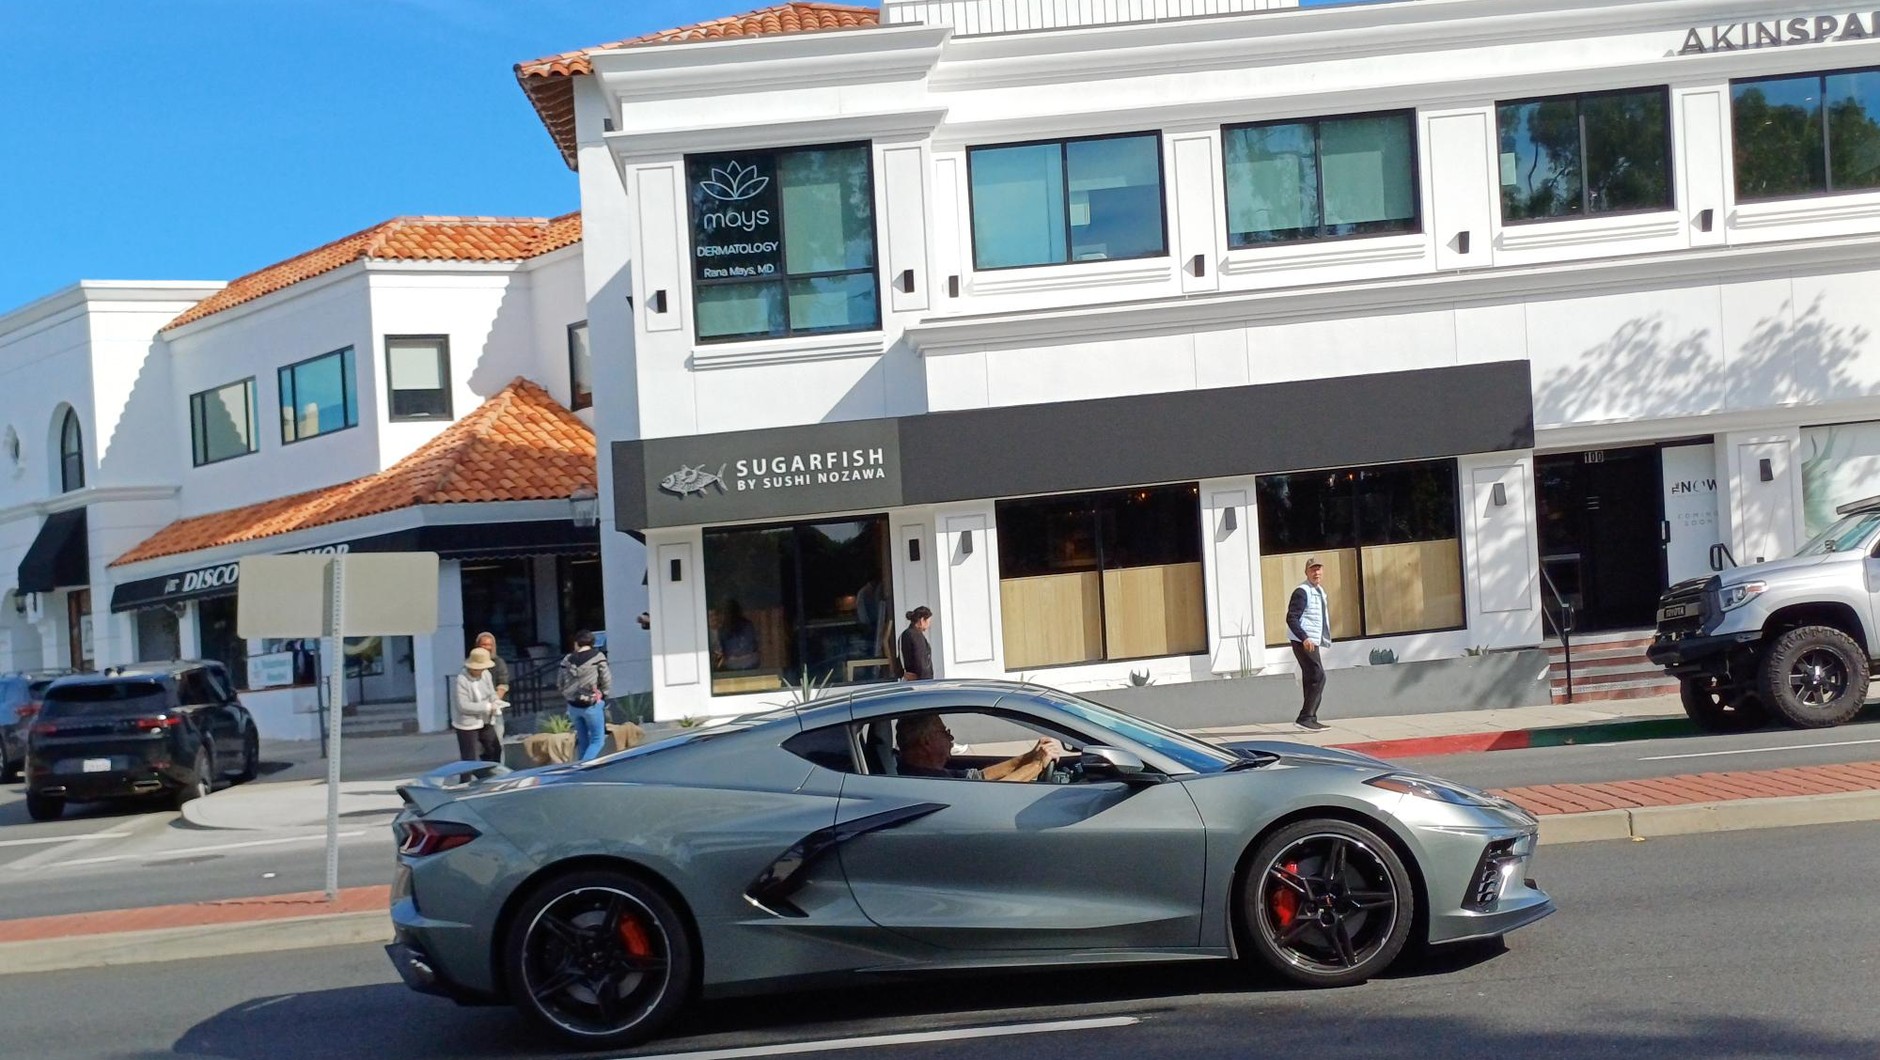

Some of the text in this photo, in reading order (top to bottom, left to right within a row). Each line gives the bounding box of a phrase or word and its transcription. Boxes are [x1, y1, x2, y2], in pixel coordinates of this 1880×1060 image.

[704, 210, 769, 231] mays
[697, 241, 779, 257] DERMATOLOGY
[704, 267, 728, 278] Rana
[758, 263, 774, 274] MD
[736, 448, 884, 477] SUGARFISH
[1585, 451, 1604, 464] 100
[737, 467, 885, 491] BY SUSHI NOZAWA
